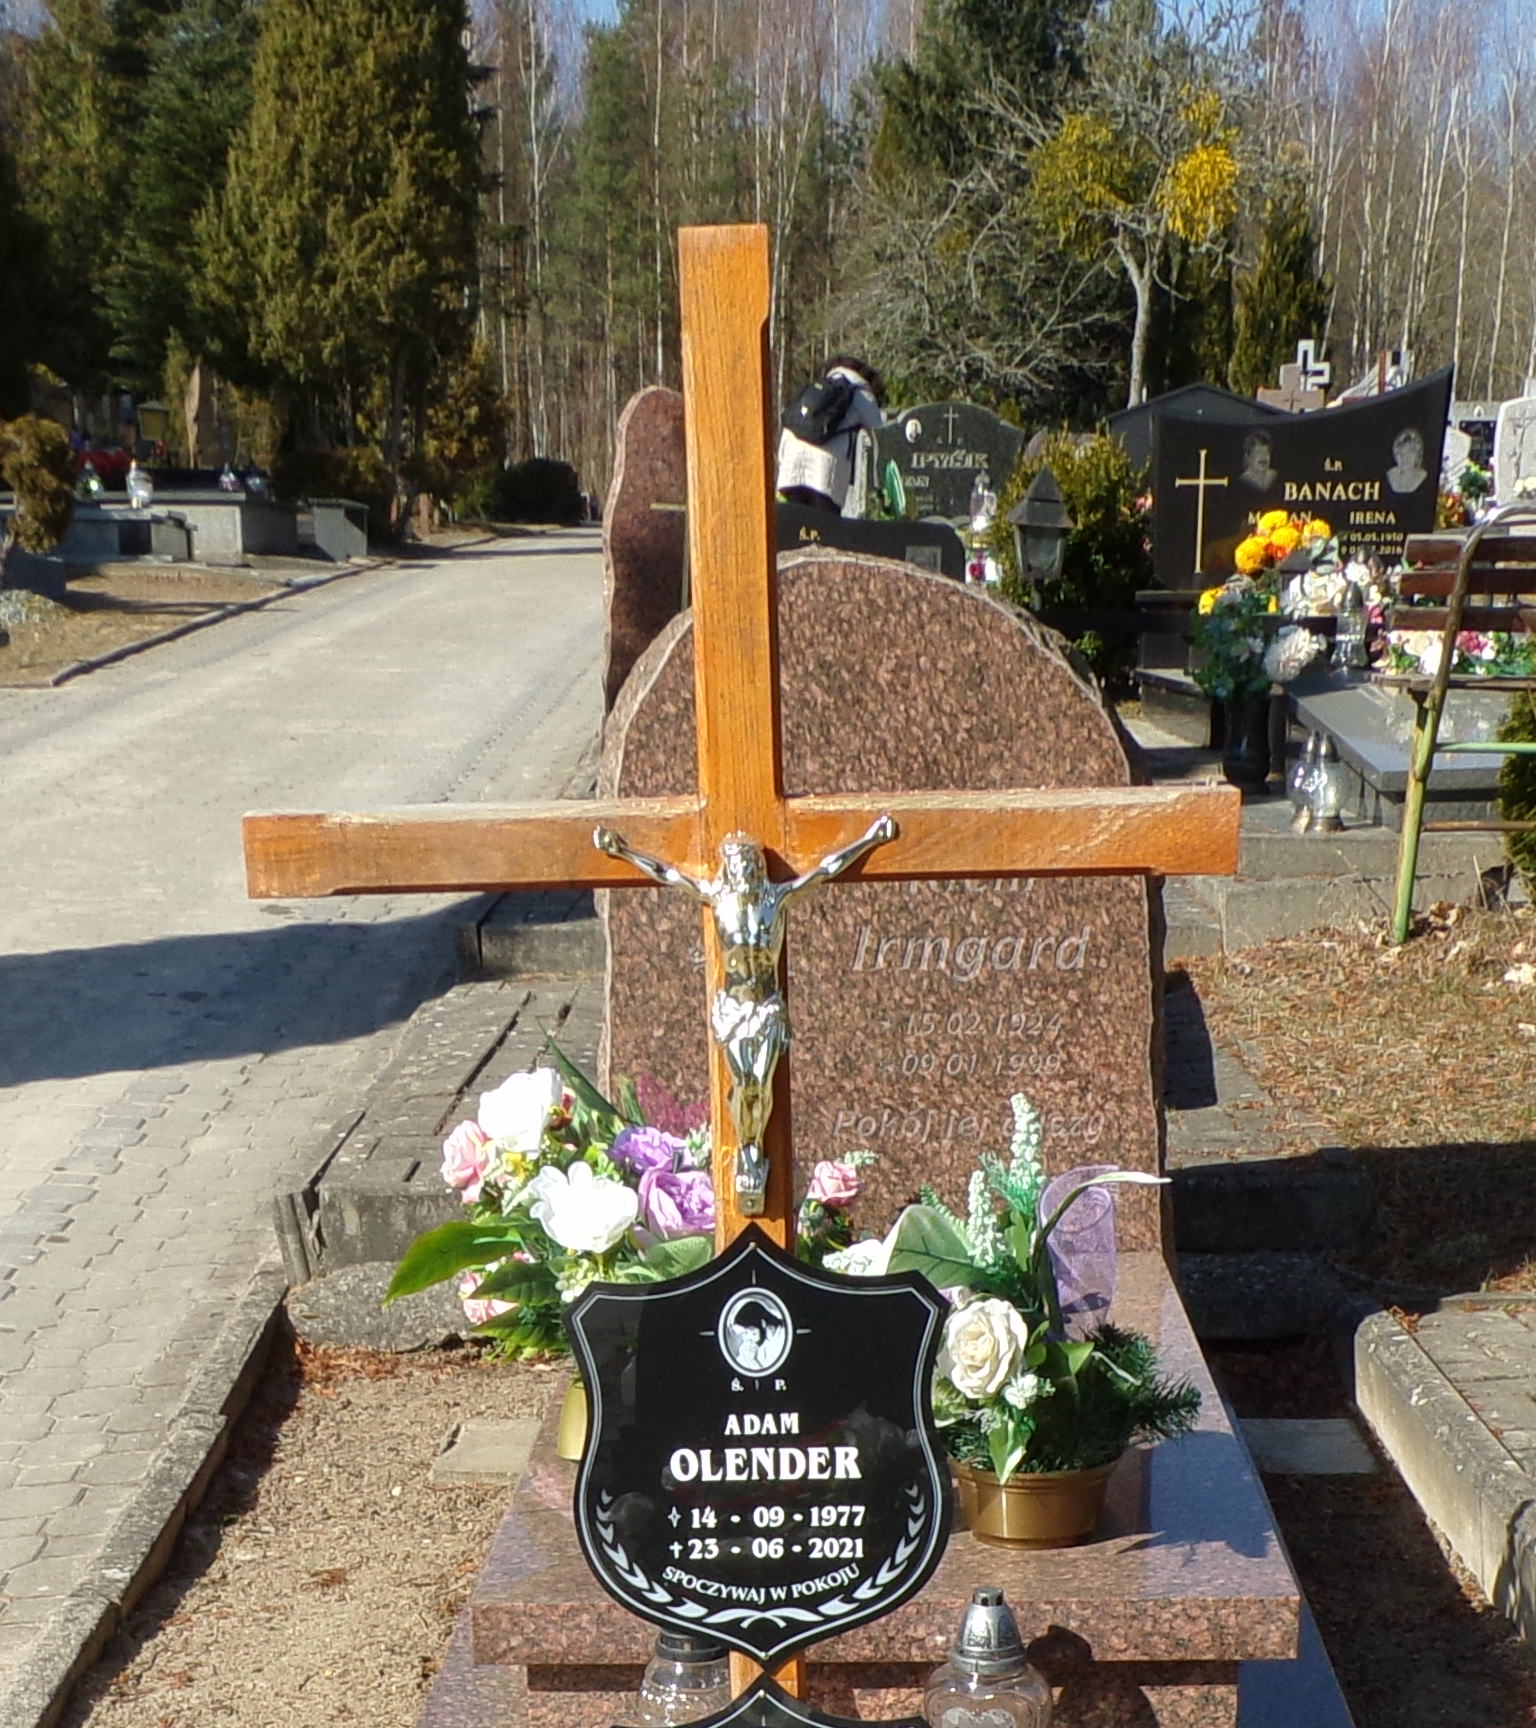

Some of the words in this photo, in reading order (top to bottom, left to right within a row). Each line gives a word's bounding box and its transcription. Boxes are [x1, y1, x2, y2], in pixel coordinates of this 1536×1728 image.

[1284, 481, 1380, 501] BANACH
[1248, 510, 1312, 525] MAN
[1349, 511, 1396, 525] IRENA
[852, 925, 1091, 982] Irmgard
[774, 1378, 787, 1391] P.
[724, 1412, 800, 1435] ADAM
[670, 1446, 862, 1482] OLENDER
[691, 1506, 717, 1528] 14
[753, 1506, 785, 1528] 09
[809, 1505, 866, 1528] 1977
[688, 1538, 719, 1560] 23
[752, 1537, 784, 1559] 06
[809, 1538, 864, 1559] 2021
[662, 1564, 765, 1605] SPOCZYWAJ
[769, 1586, 787, 1600] W
[791, 1563, 862, 1597] POKOJU
